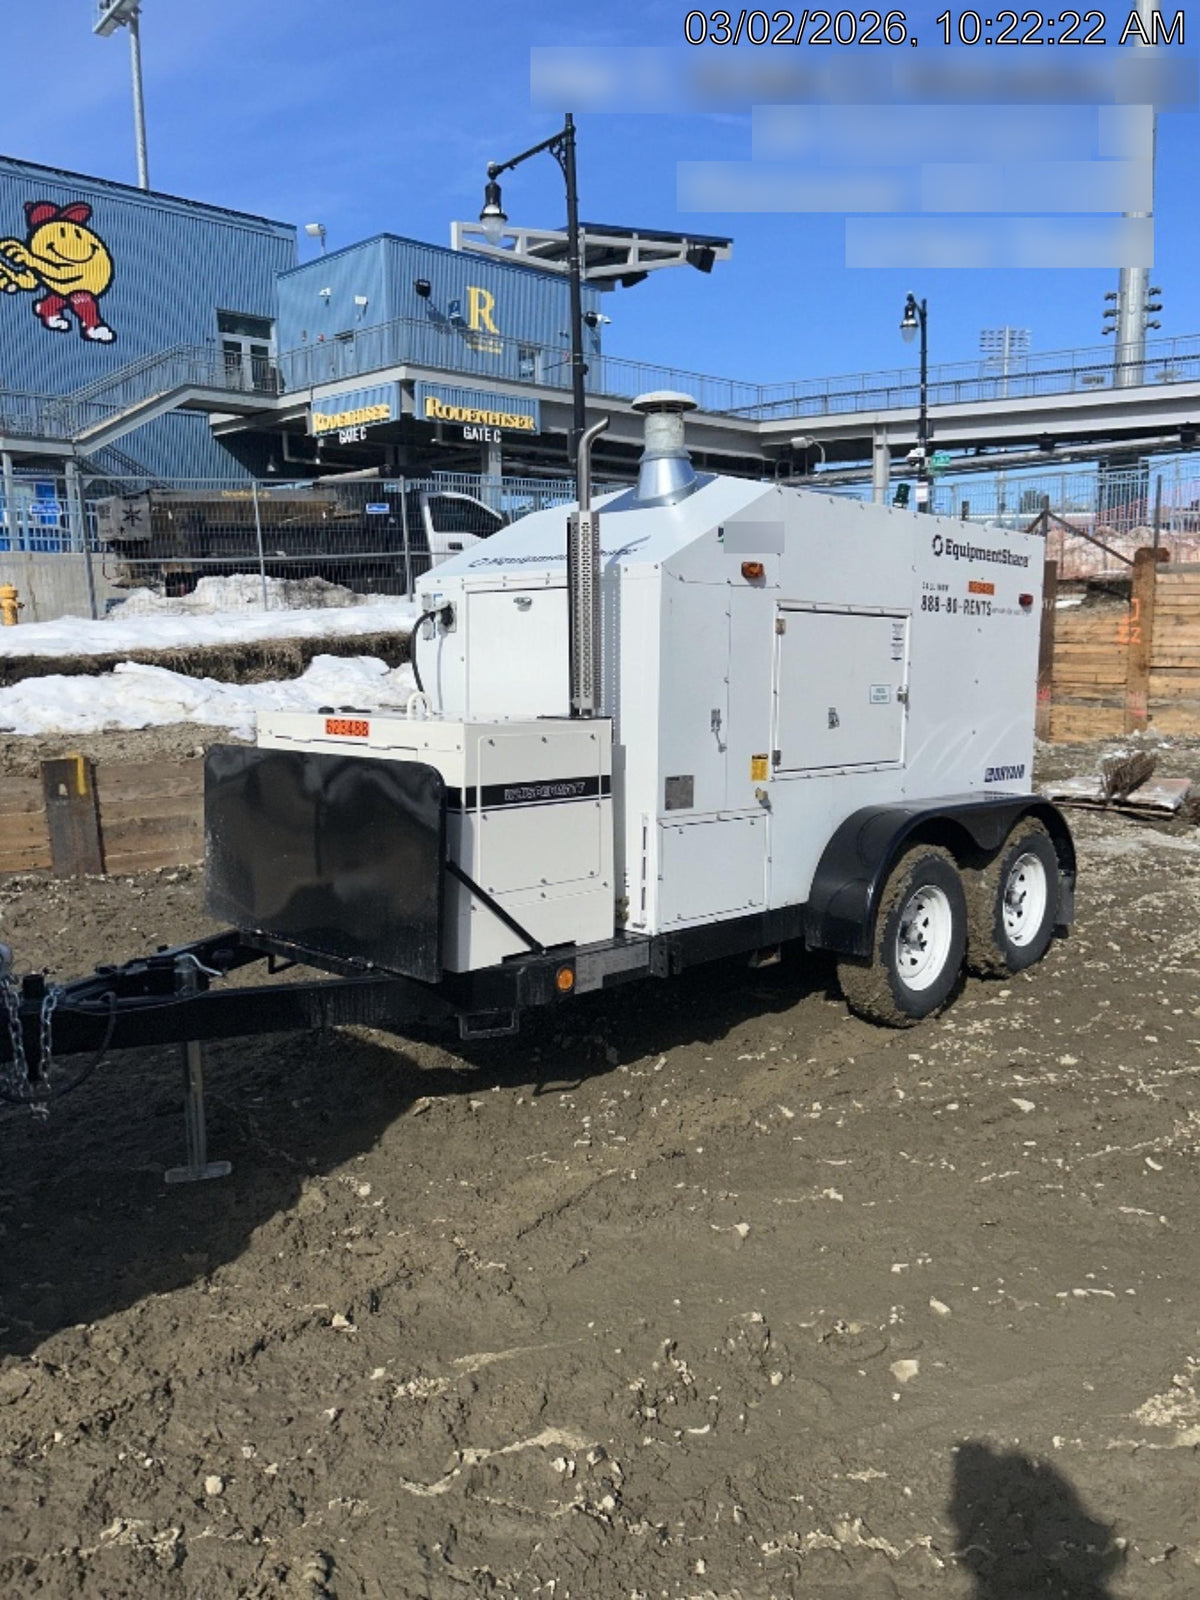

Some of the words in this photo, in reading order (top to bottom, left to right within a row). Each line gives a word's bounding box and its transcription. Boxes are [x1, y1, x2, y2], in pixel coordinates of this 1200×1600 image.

[466, 286, 500, 334] R
[463, 425, 492, 442] GATE
[945, 538, 1029, 568] EquipmentShare
